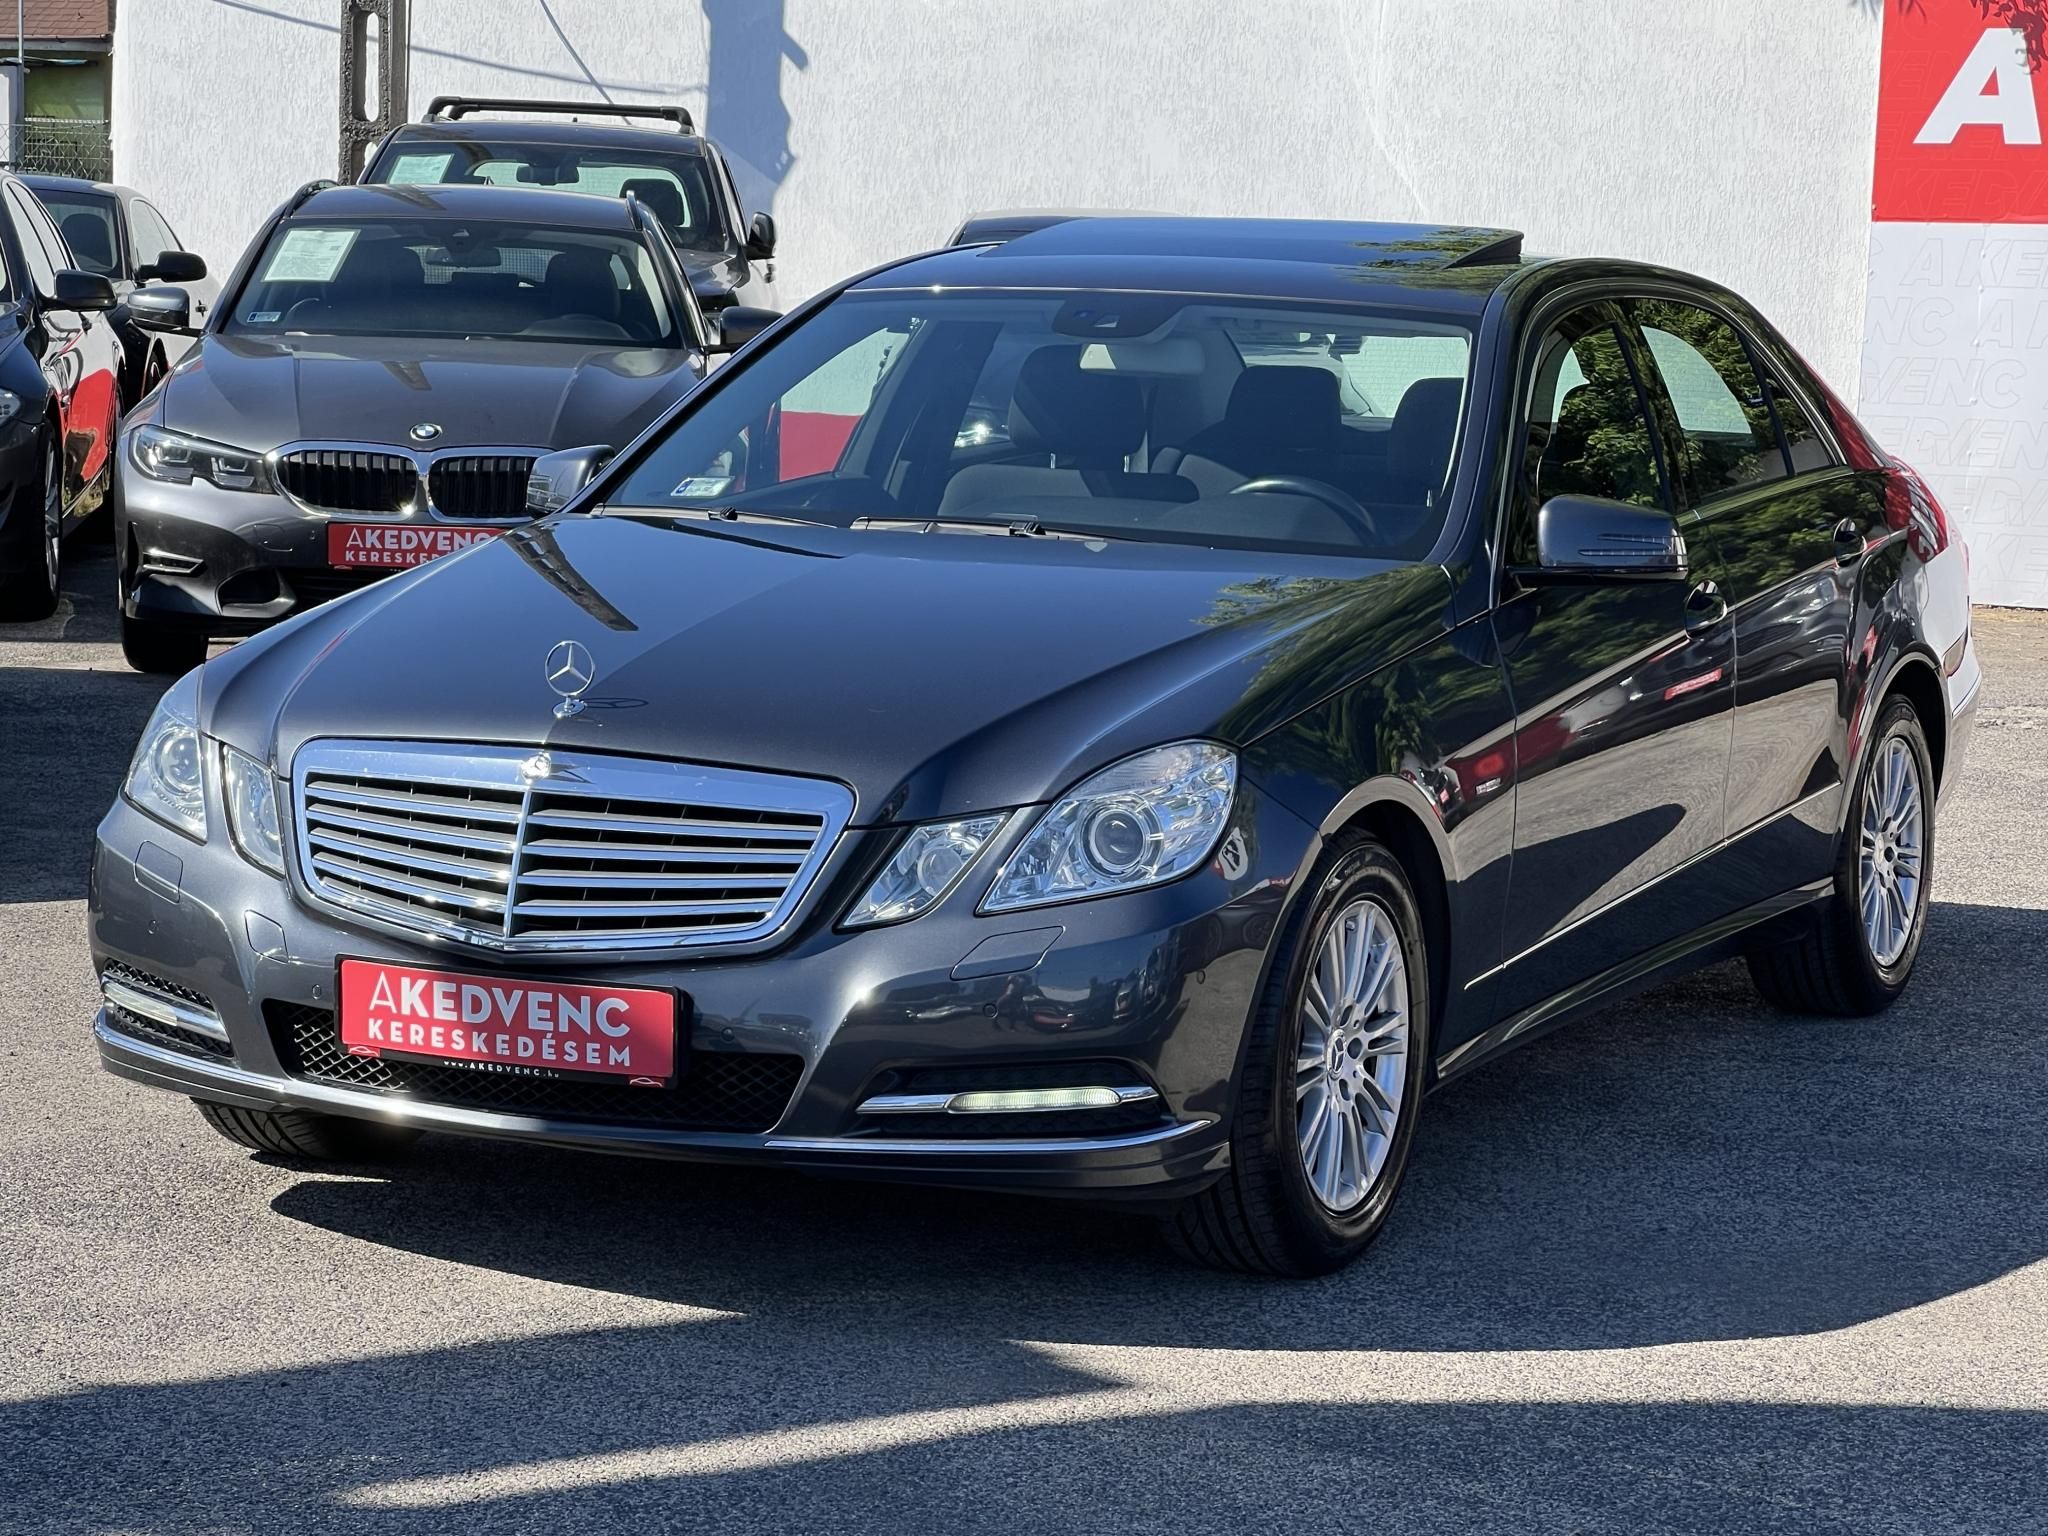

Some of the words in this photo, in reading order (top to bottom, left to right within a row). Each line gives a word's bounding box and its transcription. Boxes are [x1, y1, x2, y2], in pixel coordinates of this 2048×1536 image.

[1913, 28, 2042, 145] A
[369, 970, 631, 1038] AKEDVENC
[368, 1018, 631, 1067] KERESKEDÉSEM
